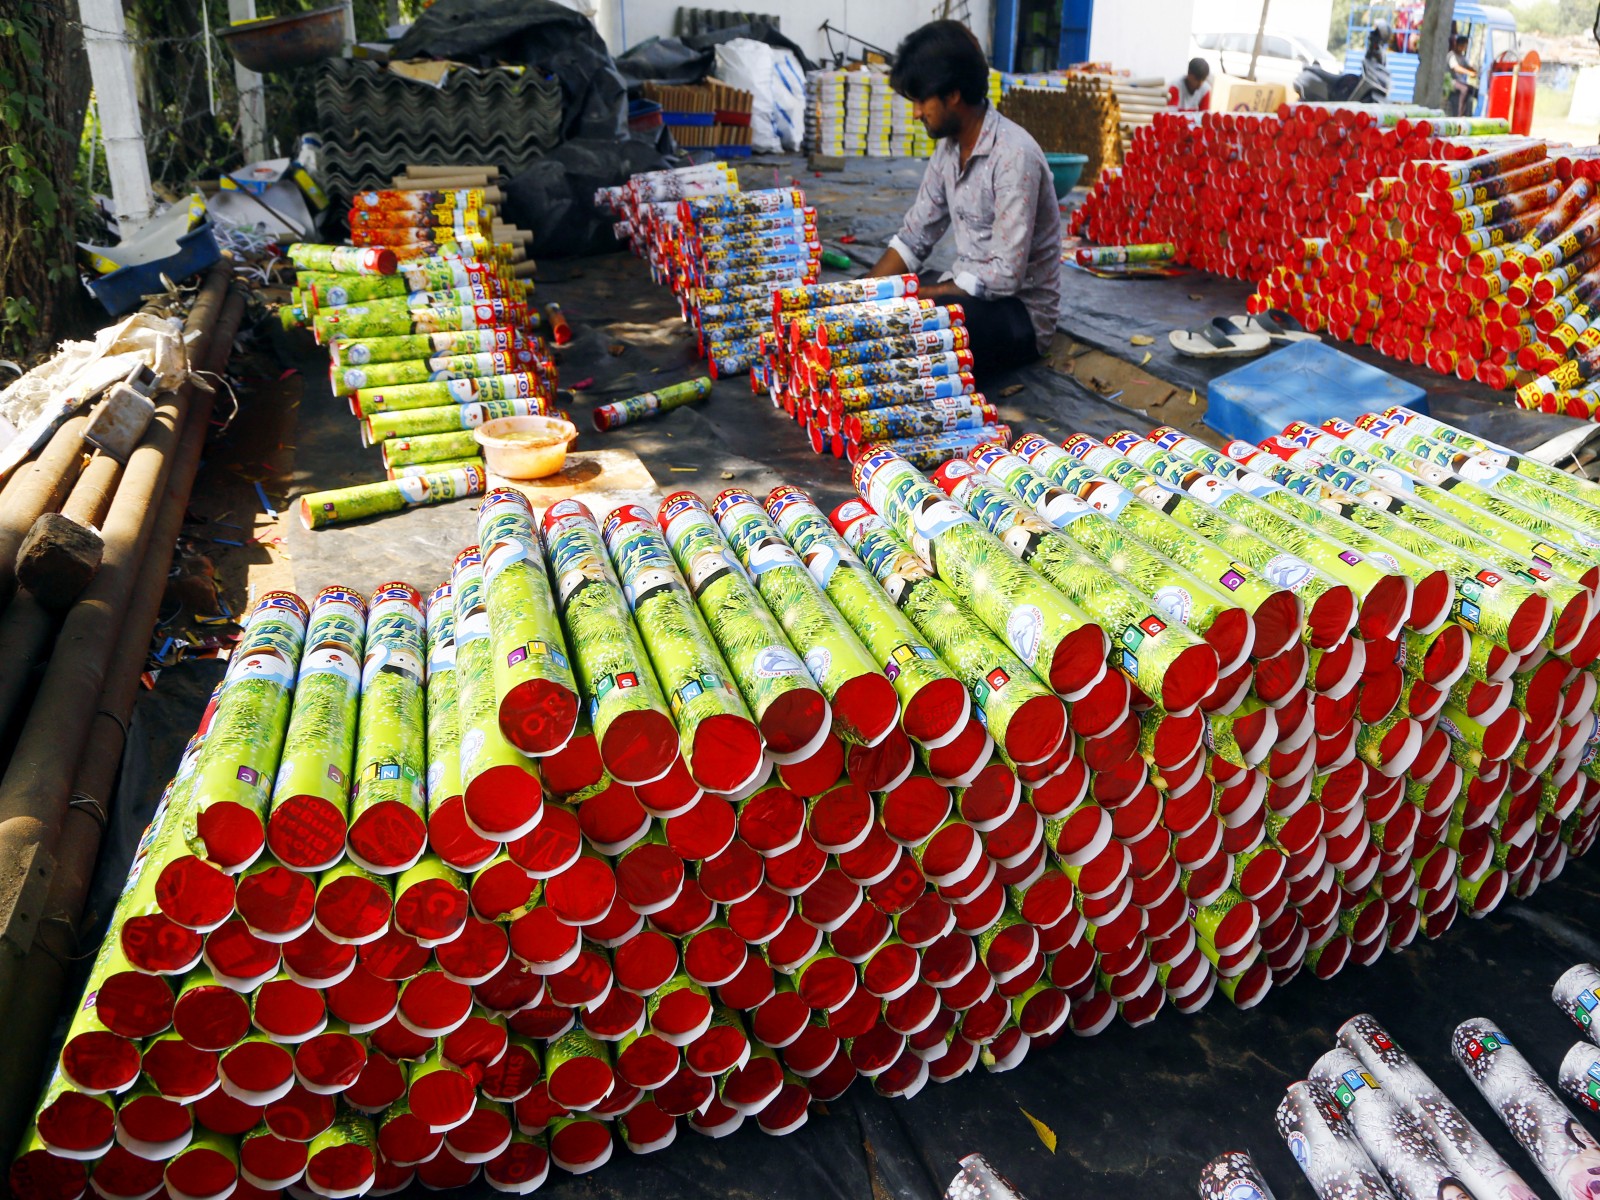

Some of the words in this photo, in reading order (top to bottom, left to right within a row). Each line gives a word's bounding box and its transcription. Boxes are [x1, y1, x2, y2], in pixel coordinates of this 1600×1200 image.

[661, 494, 697, 514] INDIA
[382, 583, 415, 594] FIRE
[1031, 607, 1044, 634] SONIC
